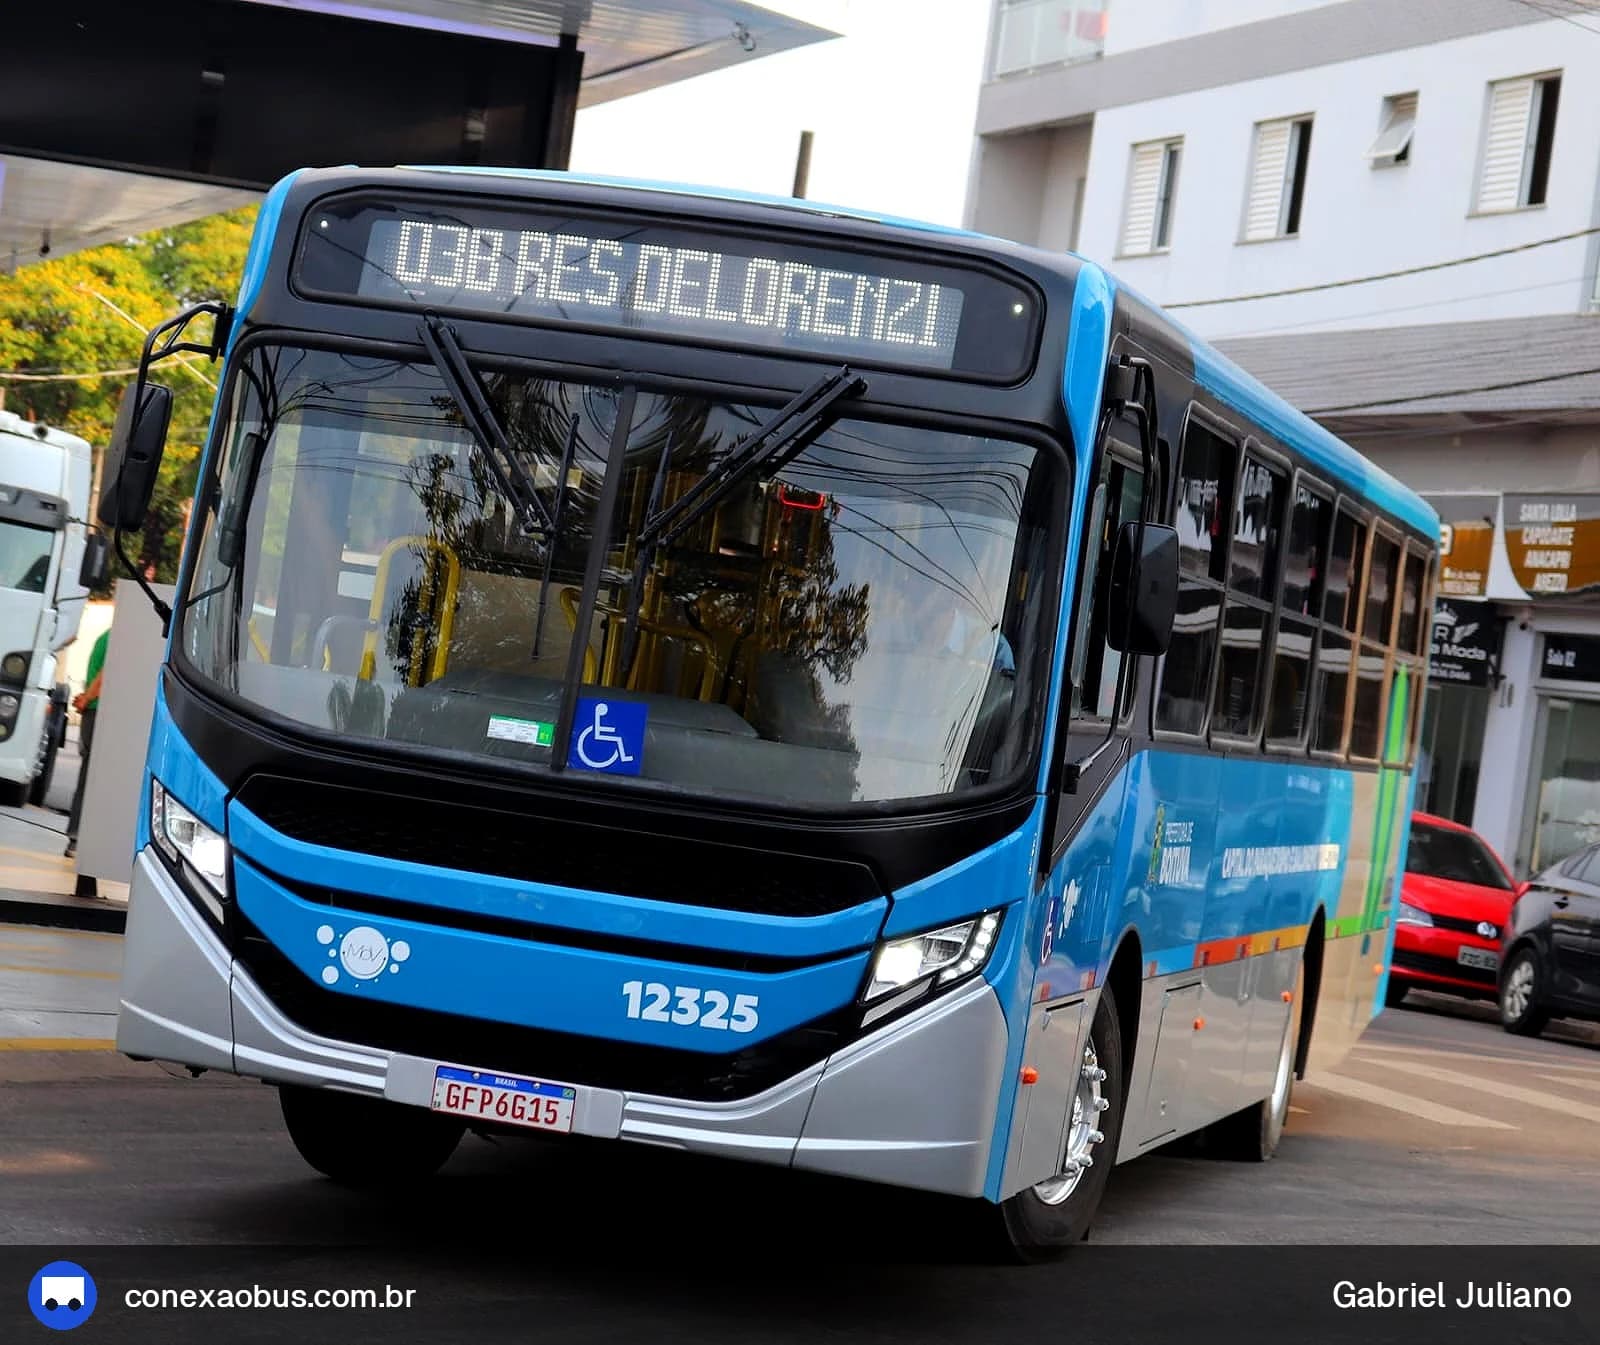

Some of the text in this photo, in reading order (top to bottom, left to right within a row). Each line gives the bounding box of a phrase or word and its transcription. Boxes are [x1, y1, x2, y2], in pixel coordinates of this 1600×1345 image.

[513, 230, 624, 306] RES
[633, 243, 941, 347] DELORENZI
[622, 980, 759, 1033] 12325
[446, 1083, 560, 1125] GFP6G15
[495, 1077, 518, 1088] BRASIL
